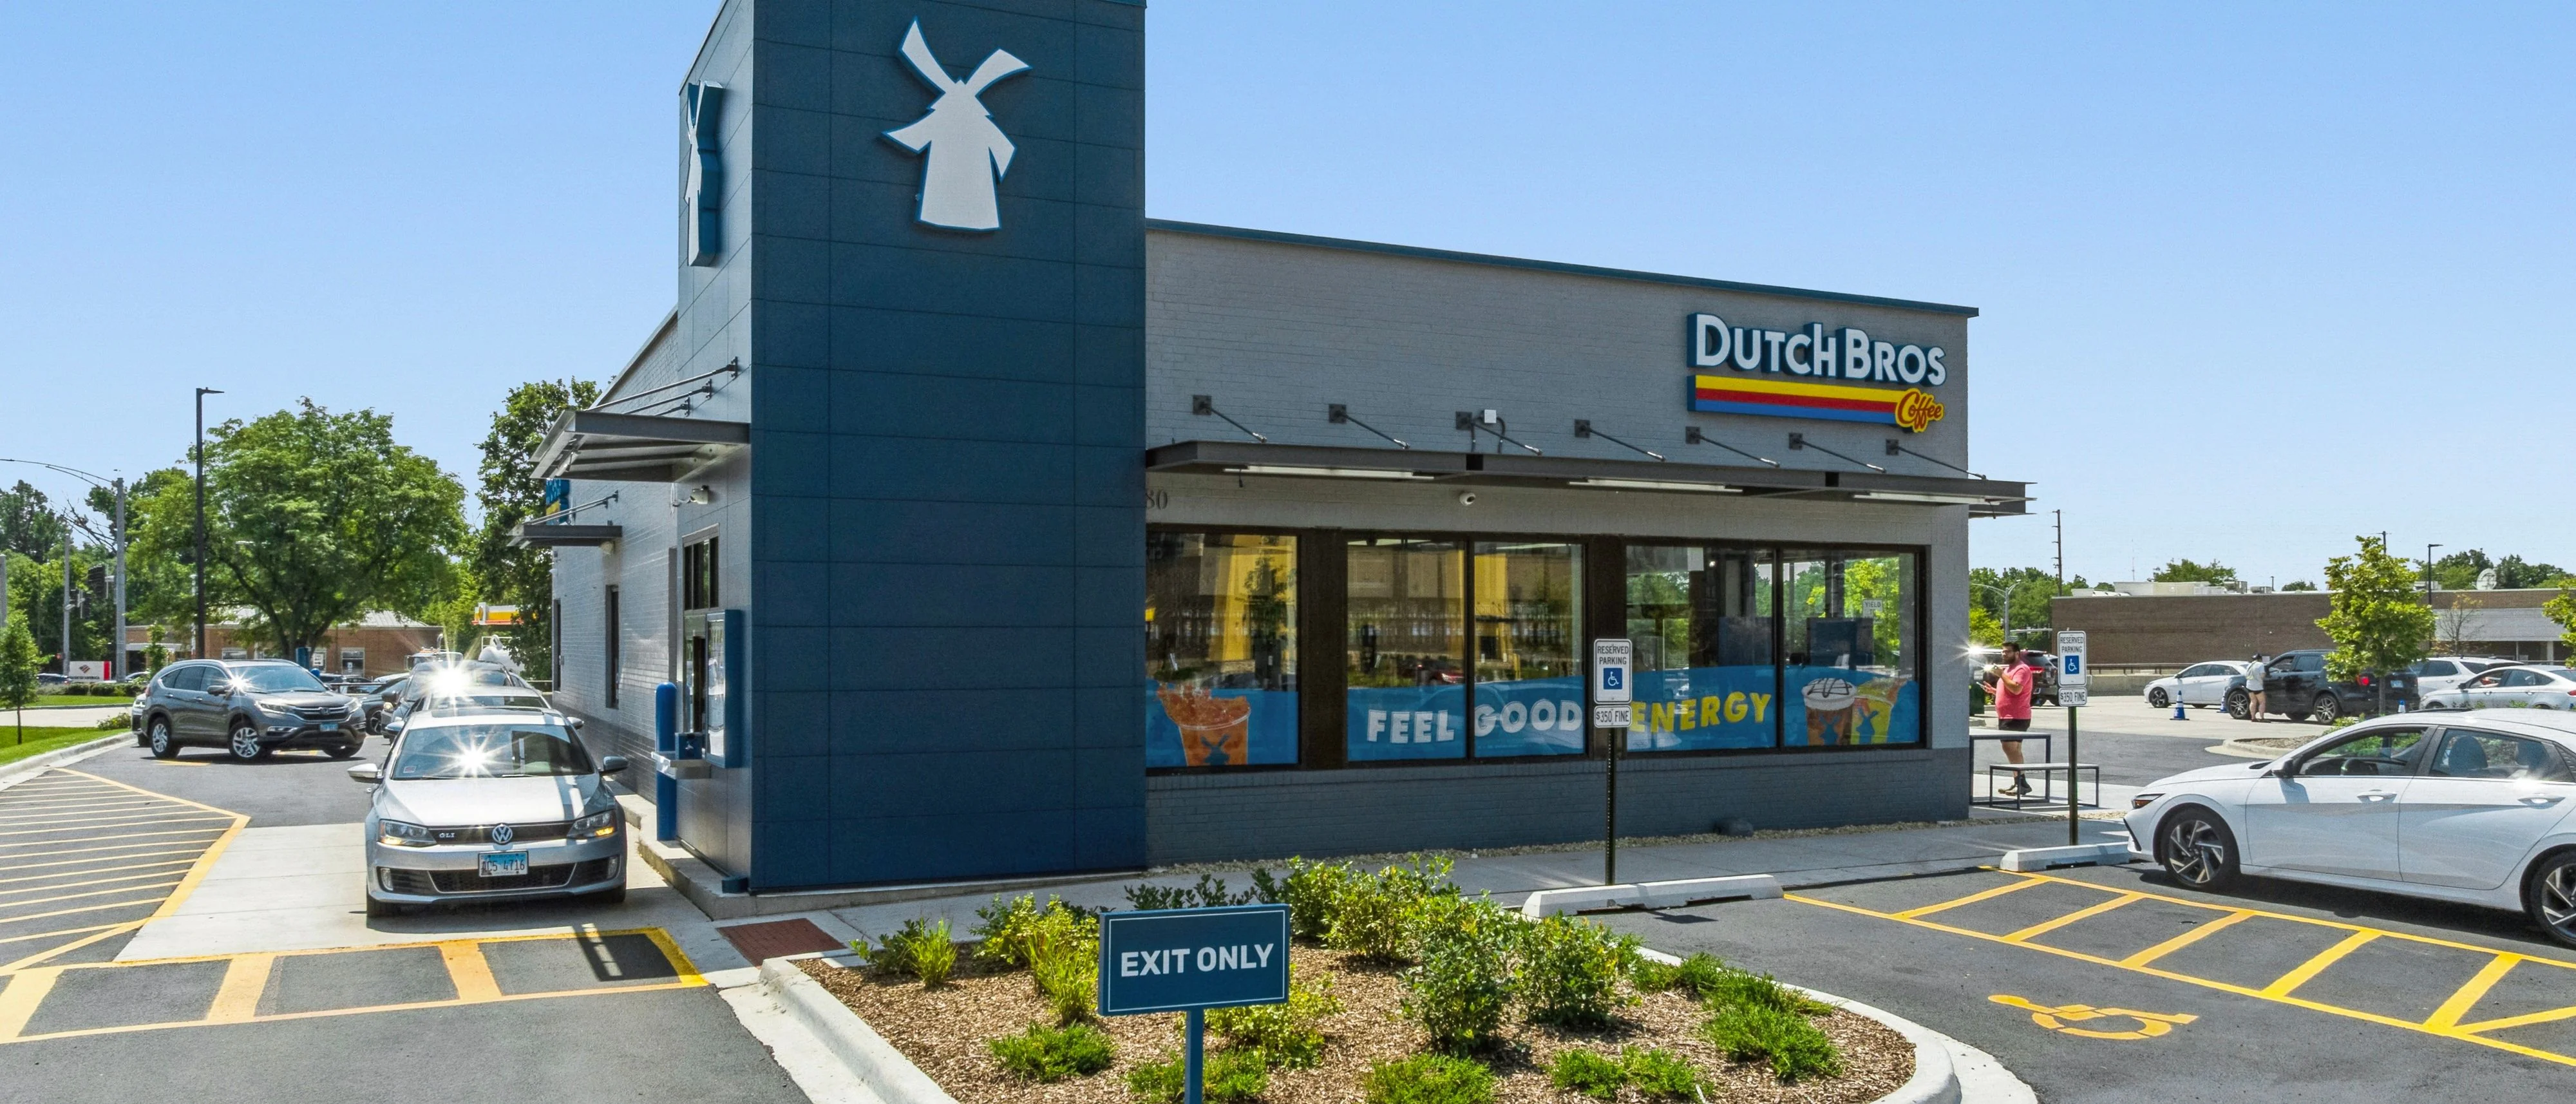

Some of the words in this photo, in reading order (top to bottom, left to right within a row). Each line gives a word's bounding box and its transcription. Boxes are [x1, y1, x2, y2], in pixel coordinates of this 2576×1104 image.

[1696, 313, 1837, 376] DUTCH
[1844, 328, 1946, 386] BROS
[1897, 391, 1942, 430] Coffee
[1597, 645, 1629, 654] RESERVED
[1599, 656, 1627, 665] PARKING
[2061, 692, 2073, 702] $350
[2074, 692, 2085, 702] FINE
[1367, 709, 1454, 744] FEEL
[1475, 698, 1583, 737] GOOD
[1629, 691, 1772, 733] ENERGY
[1596, 710, 1613, 722] $350
[1615, 710, 1629, 722] FINE
[1121, 948, 1190, 977] EXIT
[1197, 944, 1274, 972] ONLY
